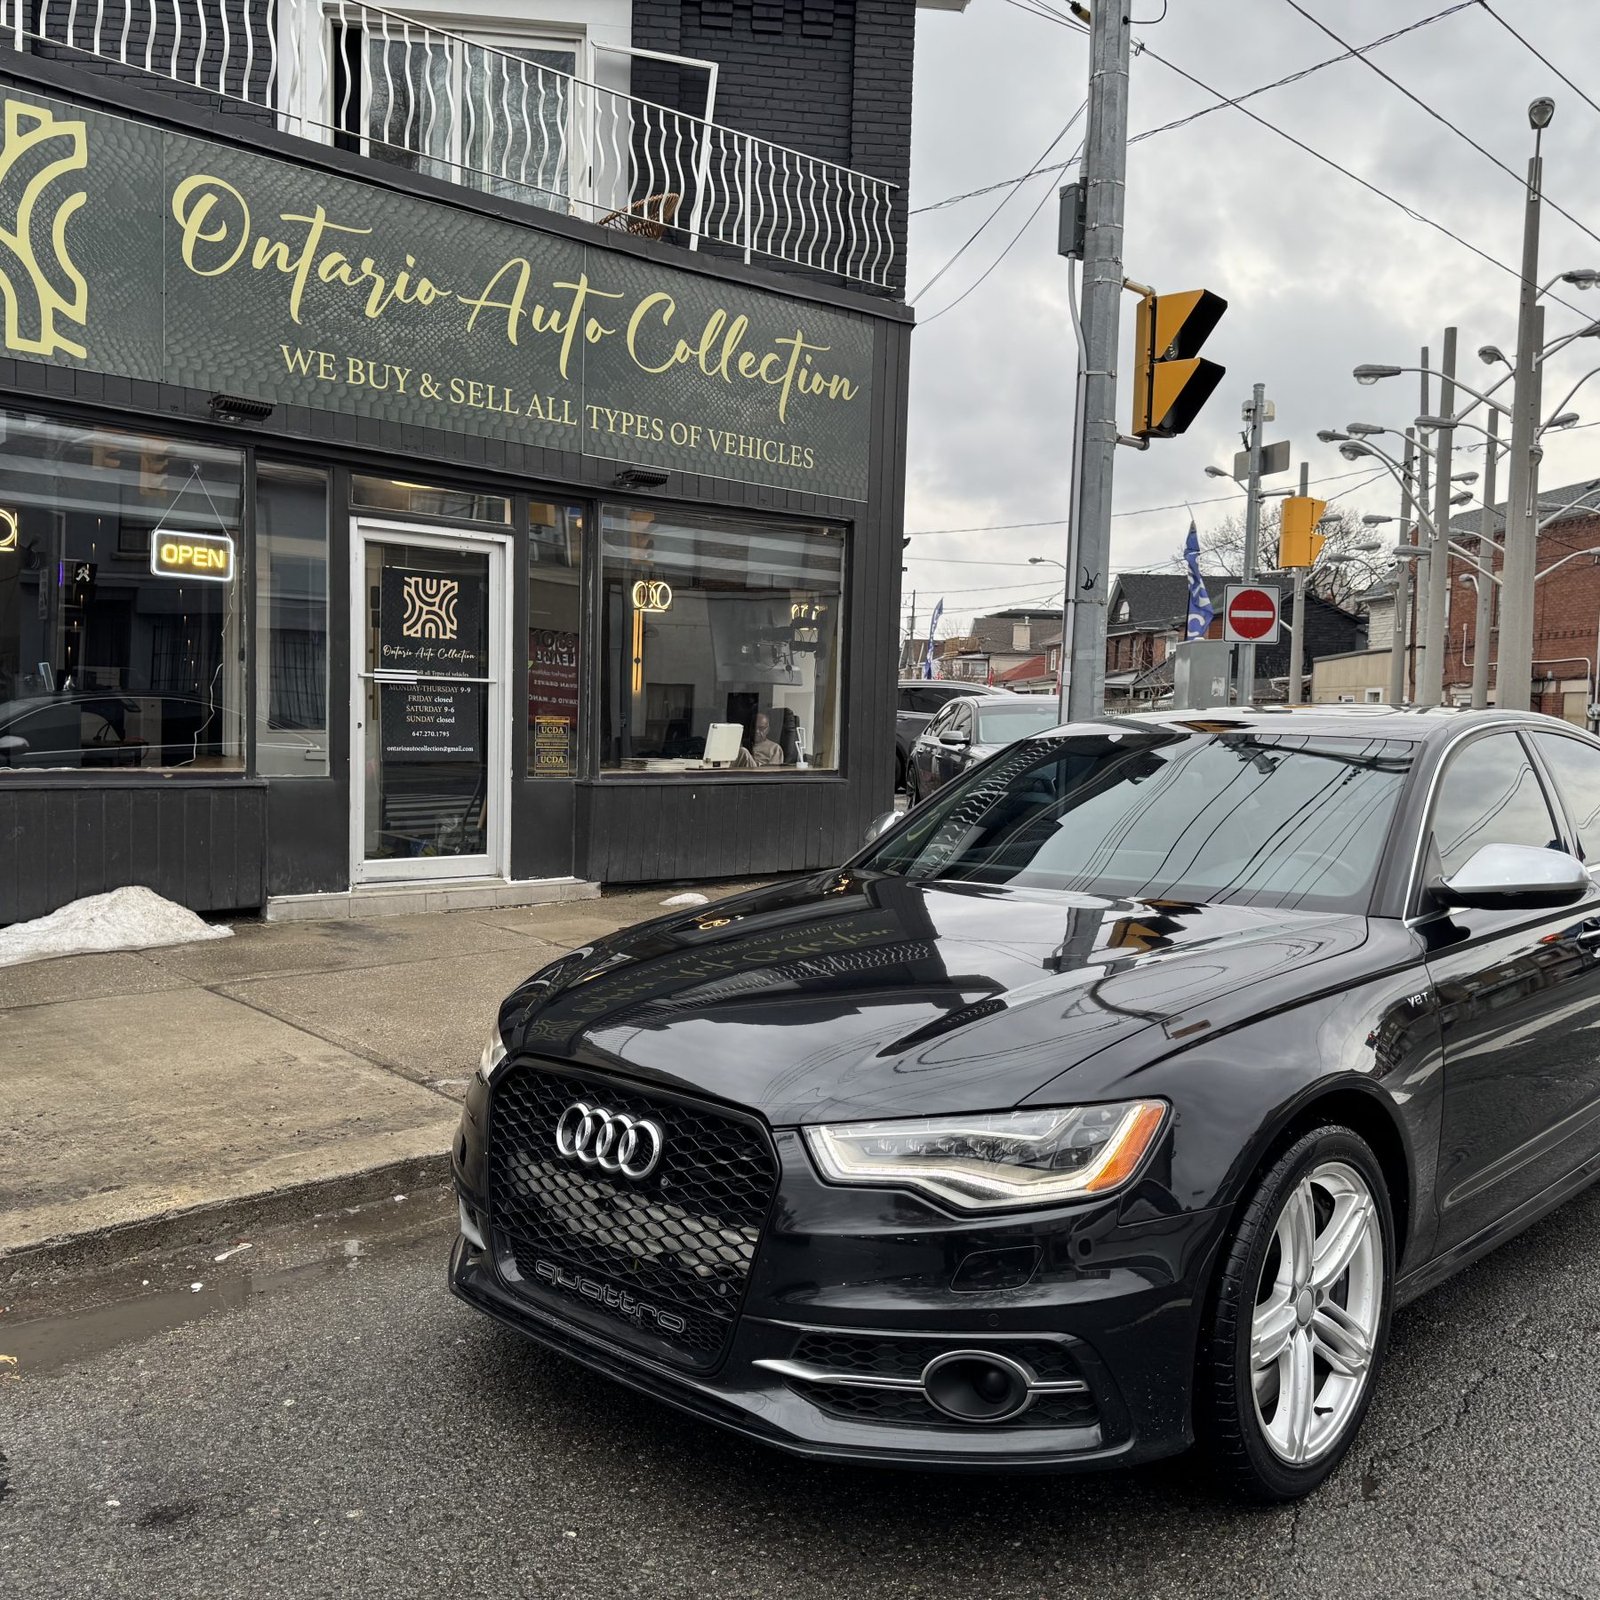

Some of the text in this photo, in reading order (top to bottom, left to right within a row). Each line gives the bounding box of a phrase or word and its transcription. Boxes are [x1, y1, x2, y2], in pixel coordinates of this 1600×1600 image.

[172, 174, 859, 424] Ontario Auto Collection
[279, 344, 814, 469] WE BUY & SELL ALL TYPES OF VEHICLES
[161, 543, 225, 569] OPEN
[383, 644, 476, 663] Ontario Auto Collection
[389, 684, 459, 693] MONDAY-THURSDAY
[406, 705, 442, 713] SATURDAY
[406, 715, 435, 723] SUNDAY
[541, 726, 565, 734] UCDA
[386, 745, 474, 753] ontarioautocollection@gmail.com
[535, 1259, 687, 1334] quattro
